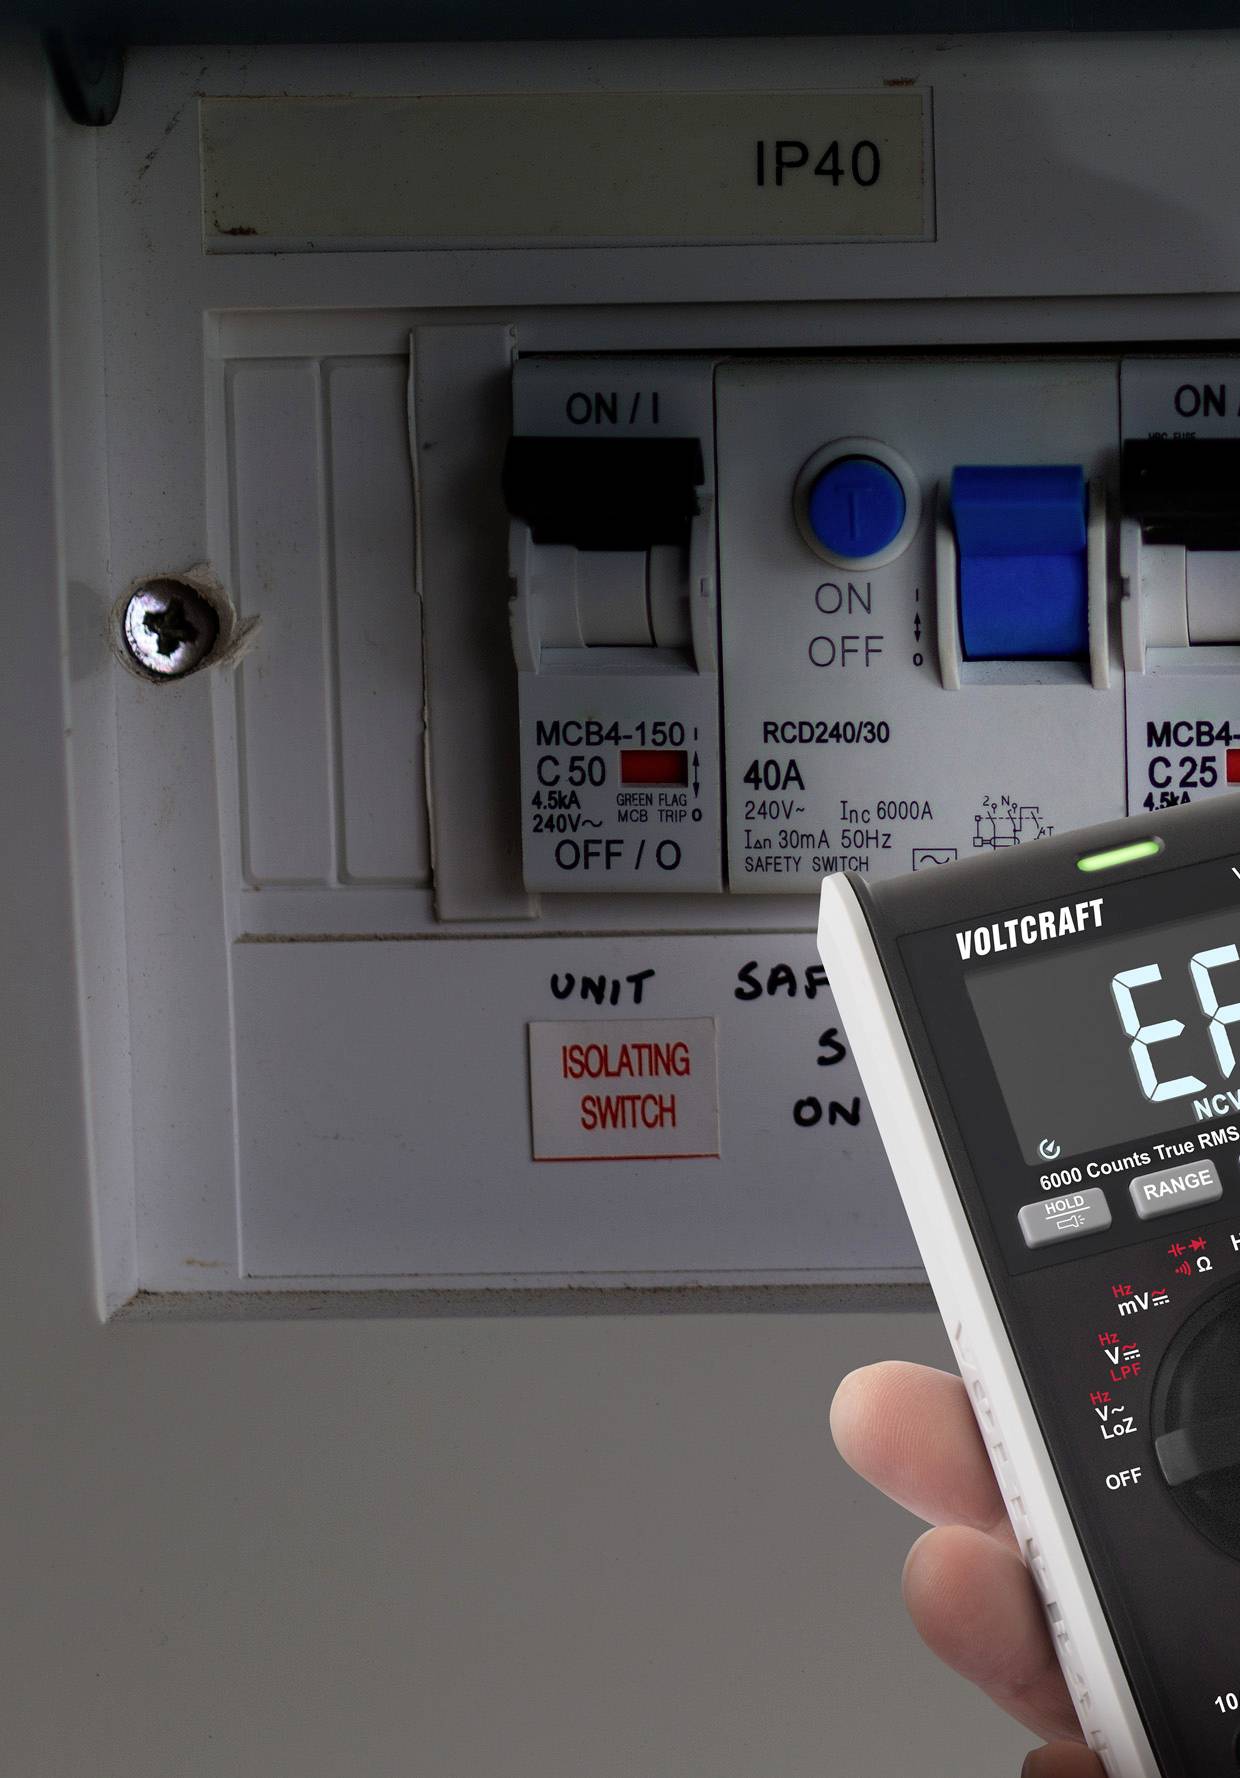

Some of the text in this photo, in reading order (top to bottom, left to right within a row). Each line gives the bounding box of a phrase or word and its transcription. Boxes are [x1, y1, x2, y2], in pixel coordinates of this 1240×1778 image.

[756, 141, 881, 188] IP40
[566, 392, 617, 424] ON
[1175, 385, 1226, 417] ON
[815, 583, 872, 614] ON
[809, 636, 884, 667] OFF
[537, 721, 685, 746] MCB4-150
[763, 721, 890, 744] RCD240/30
[537, 756, 605, 786] C 50
[744, 760, 805, 790] 40A
[1149, 756, 1217, 788] C 25
[532, 791, 580, 809] 4.5kA
[617, 794, 687, 806] GREEN FLAG
[877, 800, 933, 820] 6000A
[618, 809, 687, 822] MCB TRIP
[778, 830, 891, 849] 30mA 50Hz
[555, 840, 623, 870] OFF
[744, 856, 869, 872] SAFETY SWITCH
[956, 898, 1104, 960] VOLTCRAFT
[551, 969, 655, 1004] UNIT
[562, 1042, 690, 1078] ISOLATING
[581, 1095, 676, 1130] SWITCH
[793, 1097, 860, 1126] ON
[1040, 1167, 1083, 1191] 6000
[1086, 1150, 1151, 1179] Counts
[1154, 1139, 1195, 1161] True
[1198, 1127, 1240, 1150] RMS
[1144, 1170, 1214, 1200] RANGE
[1044, 1195, 1084, 1215] HOLD
[1112, 1282, 1133, 1299] Hz
[1098, 1330, 1119, 1346] Hz
[1110, 1362, 1142, 1382] LPF
[1091, 1390, 1110, 1406] Hz
[1101, 1417, 1137, 1439] LoZ
[1106, 1467, 1143, 1490] OFF
